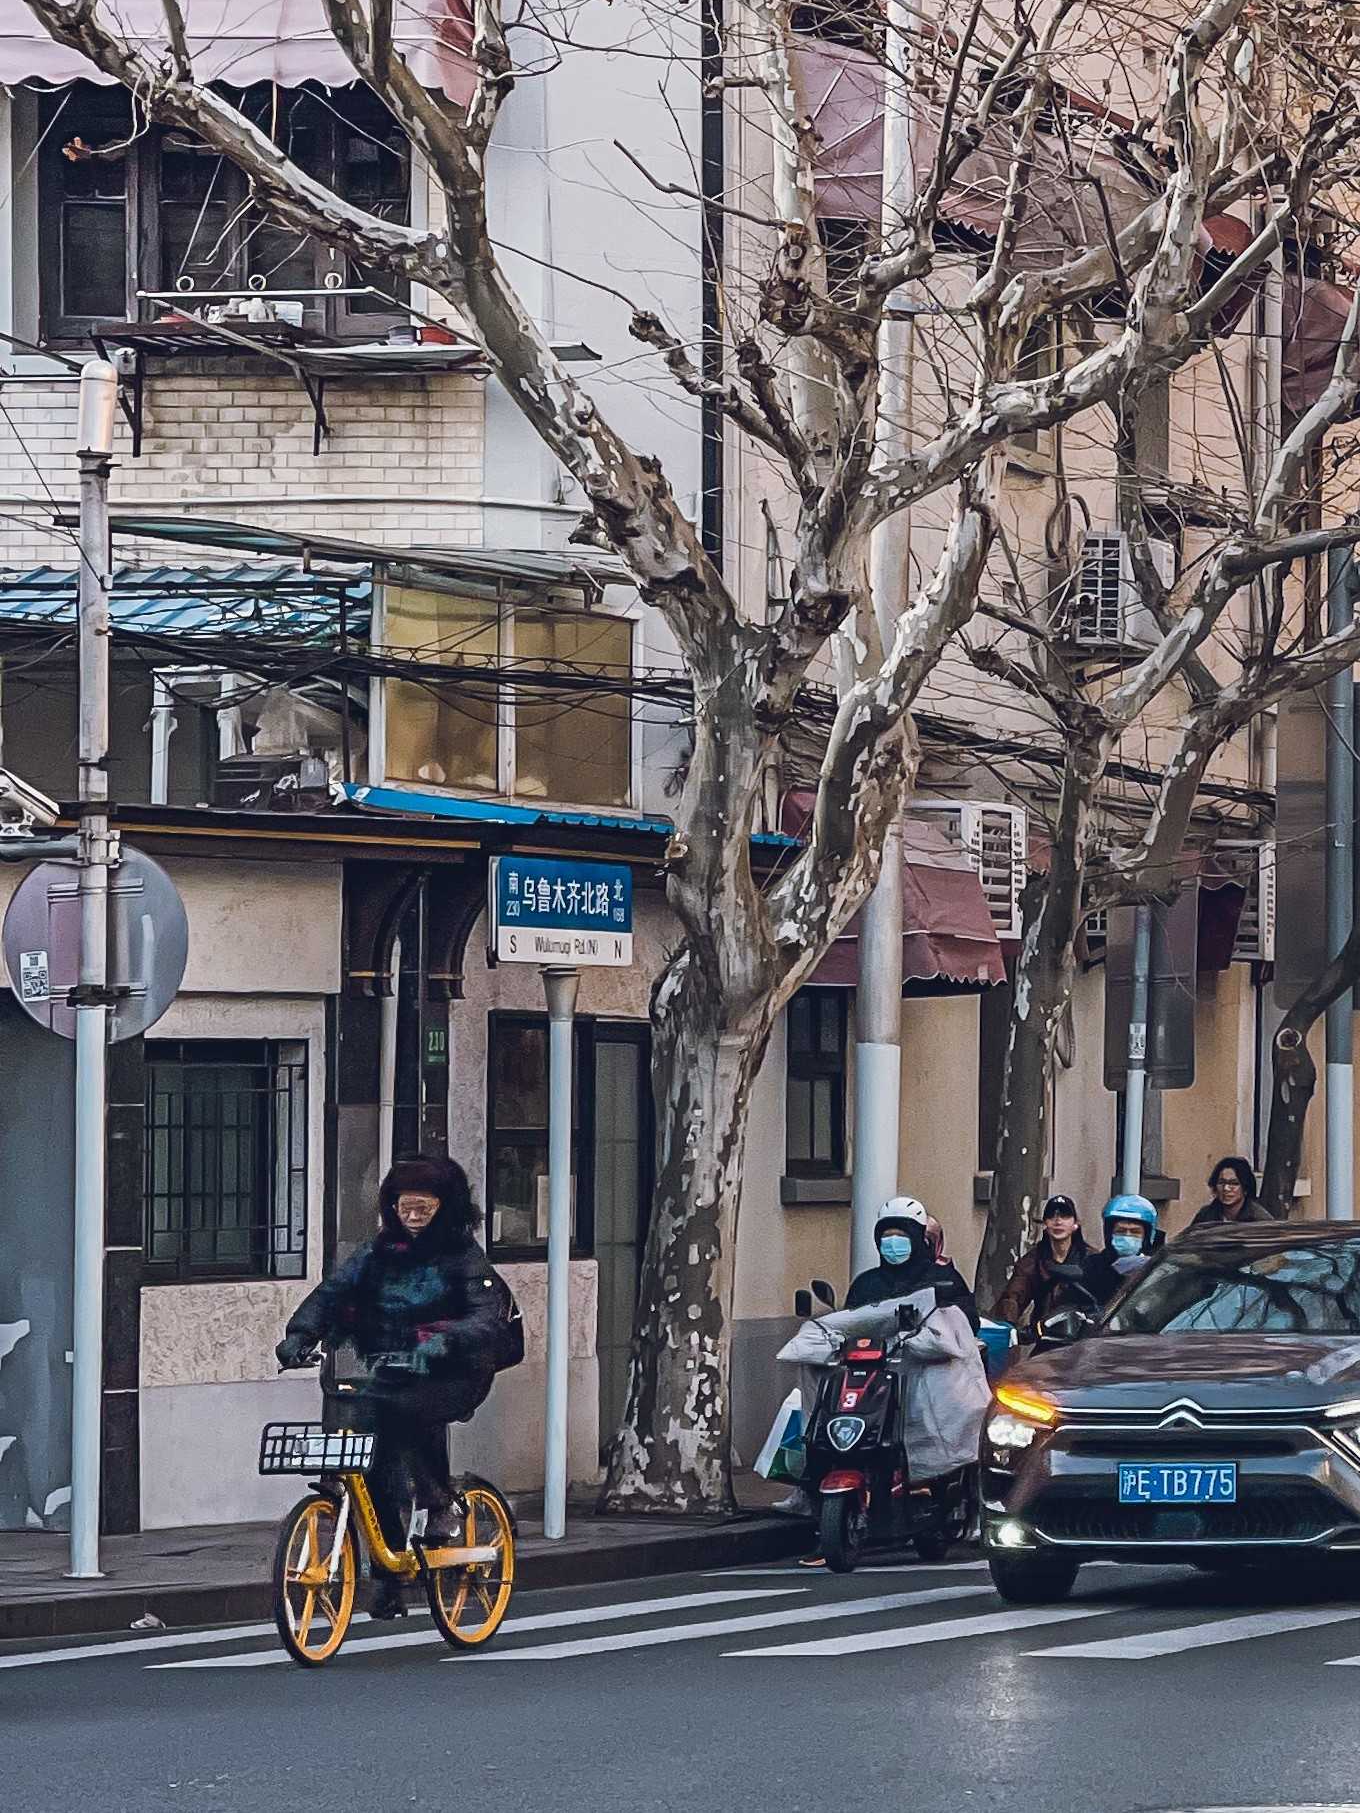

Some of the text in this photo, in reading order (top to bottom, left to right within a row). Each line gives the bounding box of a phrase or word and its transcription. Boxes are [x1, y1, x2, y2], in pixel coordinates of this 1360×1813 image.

[508, 871, 519, 895] 南
[613, 878, 624, 901] 北
[522, 876, 610, 917] 乌鲁木齐北路
[510, 934, 517, 954] S
[614, 940, 622, 959] N
